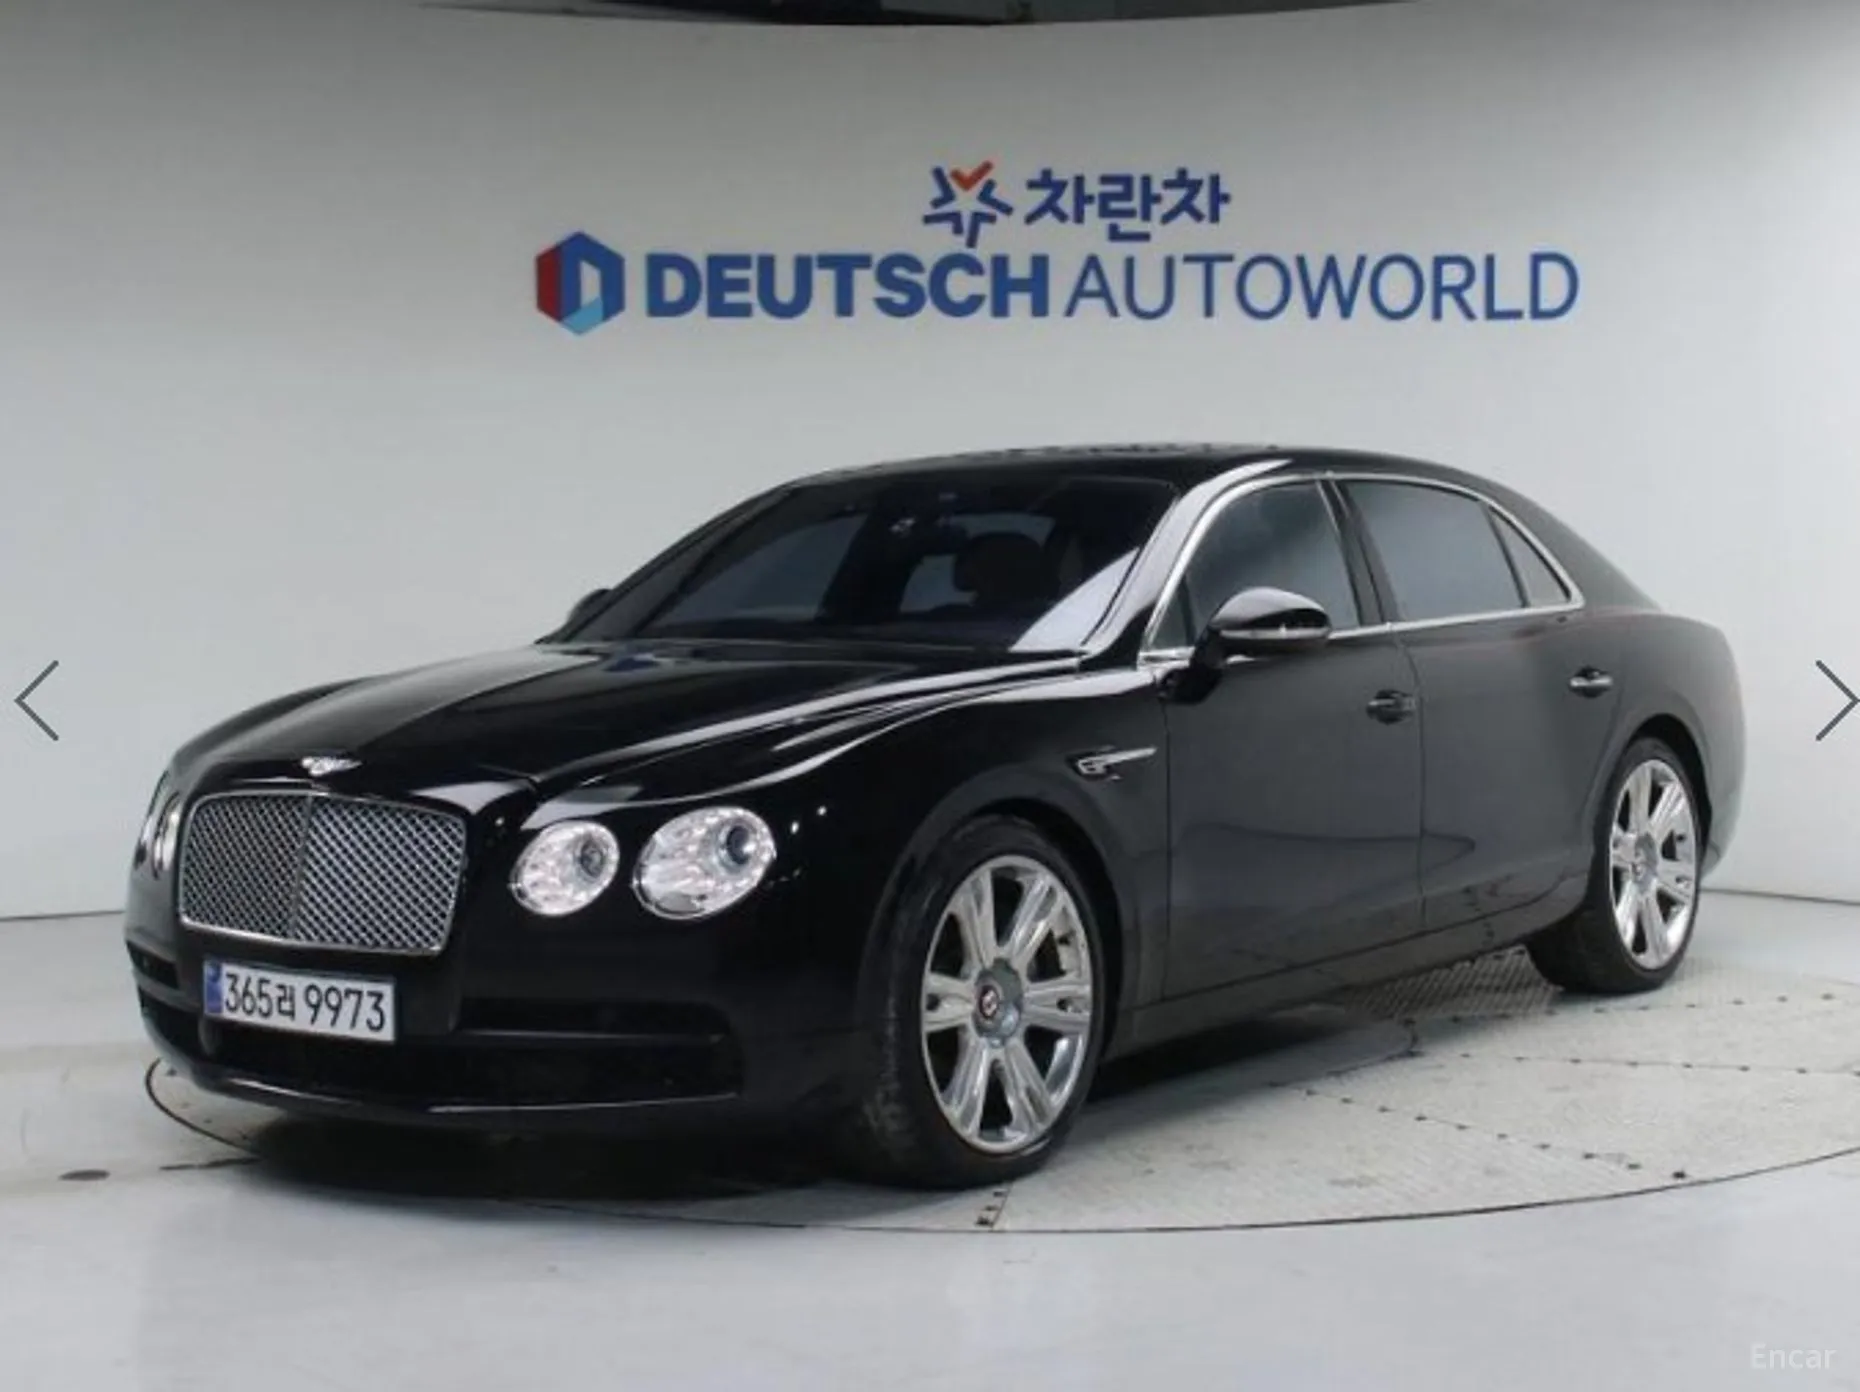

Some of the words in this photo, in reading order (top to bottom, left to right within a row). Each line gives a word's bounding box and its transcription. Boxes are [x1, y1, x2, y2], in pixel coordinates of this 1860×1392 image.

[1024, 167, 1232, 242] 차란차
[646, 252, 1049, 319] DEUTSCH
[1063, 252, 1579, 321] AUTOWORLD
[304, 983, 386, 1032] 9973
